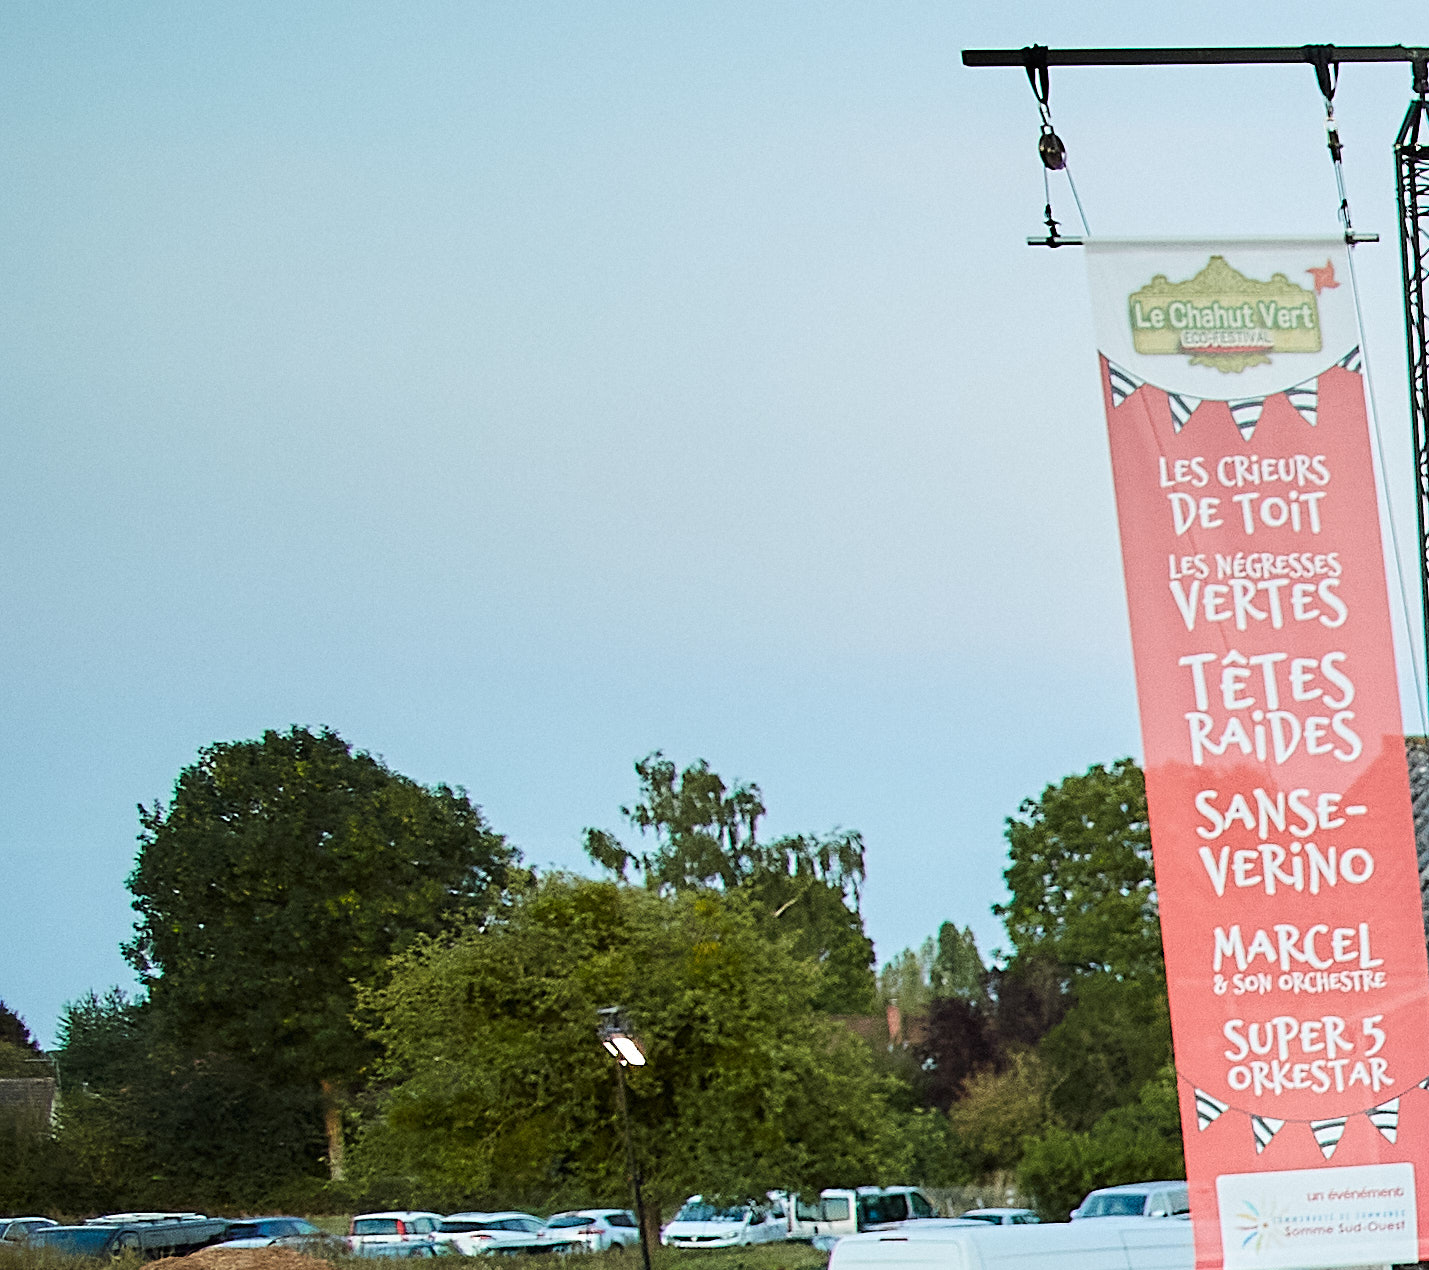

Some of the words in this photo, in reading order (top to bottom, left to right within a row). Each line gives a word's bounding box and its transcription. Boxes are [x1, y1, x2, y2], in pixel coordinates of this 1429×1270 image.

[1136, 302, 1165, 329] Le
[1172, 301, 1253, 329] Chahut
[1259, 302, 1315, 330] Vert
[1159, 456, 1210, 488] LES
[1168, 493, 1224, 536] DE
[1169, 554, 1210, 580] LES
[1216, 551, 1343, 581] NÉGRESSES
[1169, 578, 1349, 632] VERTES
[1178, 648, 1356, 712] TÊTES
[1194, 788, 1368, 841] SANSE-
[1212, 923, 1385, 971] MARCEL
[1213, 974, 1228, 995] &
[1233, 974, 1273, 994] SON
[1278, 970, 1388, 993] ORCHESTRE
[1223, 1016, 1354, 1062] SUPER
[1363, 1014, 1387, 1059] 5
[1227, 1057, 1395, 1097] ORKESTAR
